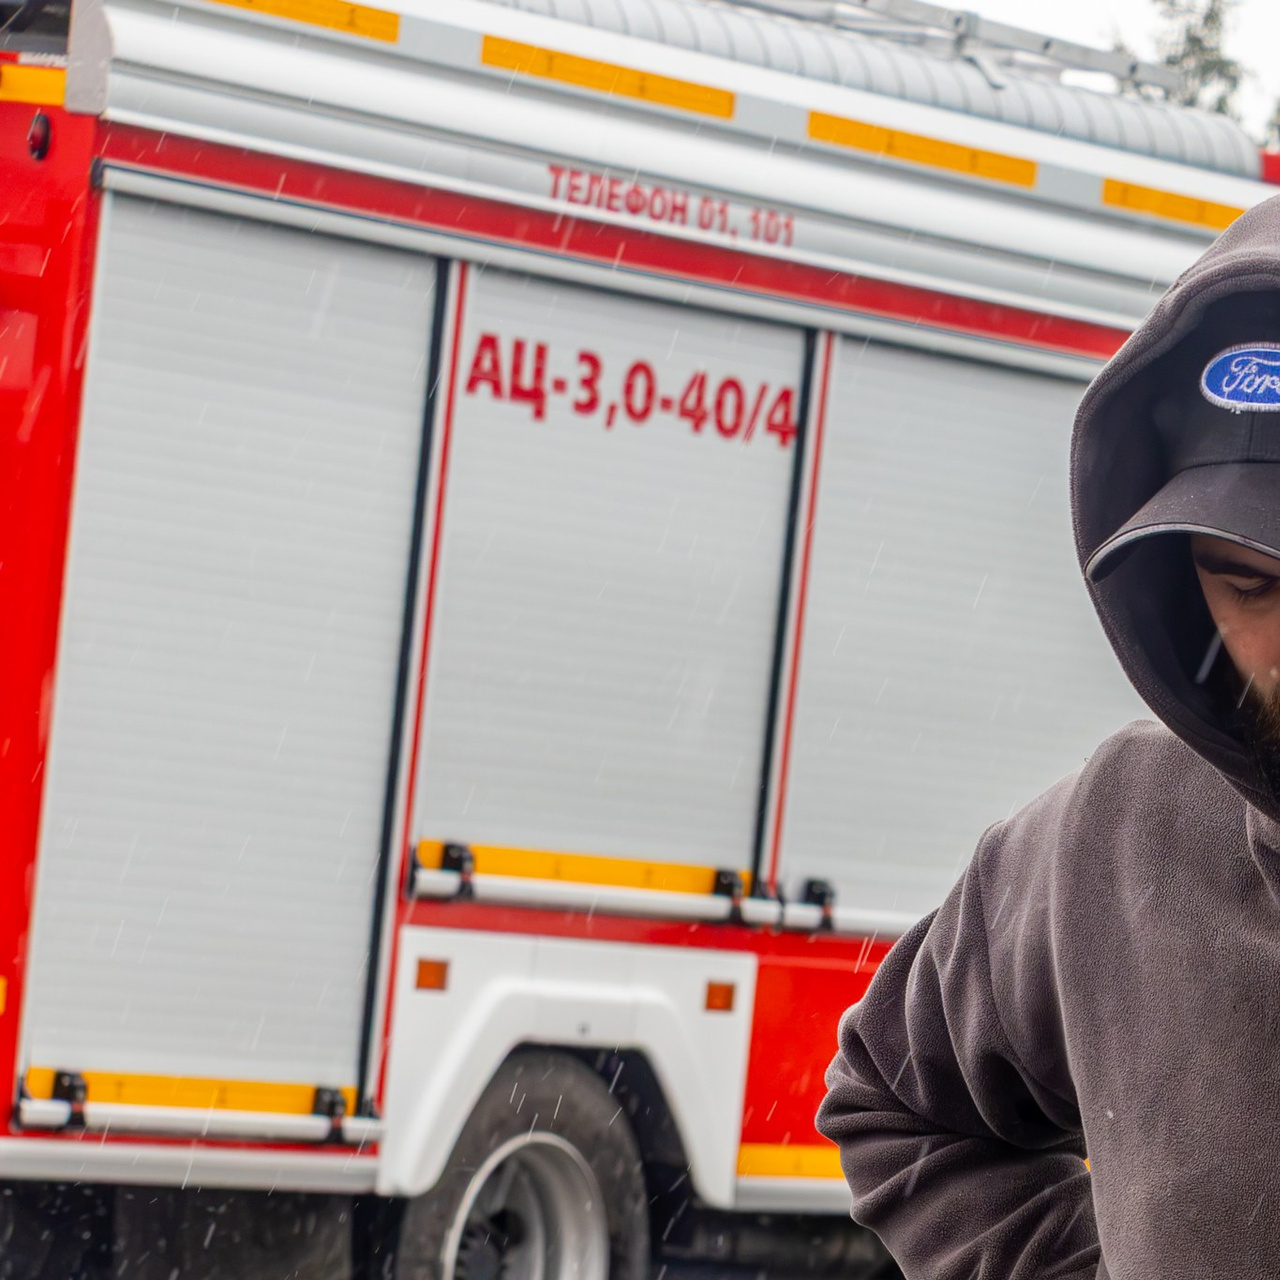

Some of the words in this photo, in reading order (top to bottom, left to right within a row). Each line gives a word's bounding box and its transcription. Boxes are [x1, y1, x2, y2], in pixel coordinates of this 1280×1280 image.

[547, 163, 690, 226] ТЕЛЕФОН
[751, 206, 795, 247] 101
[465, 332, 797, 448] АЦ-3,0-40/4
